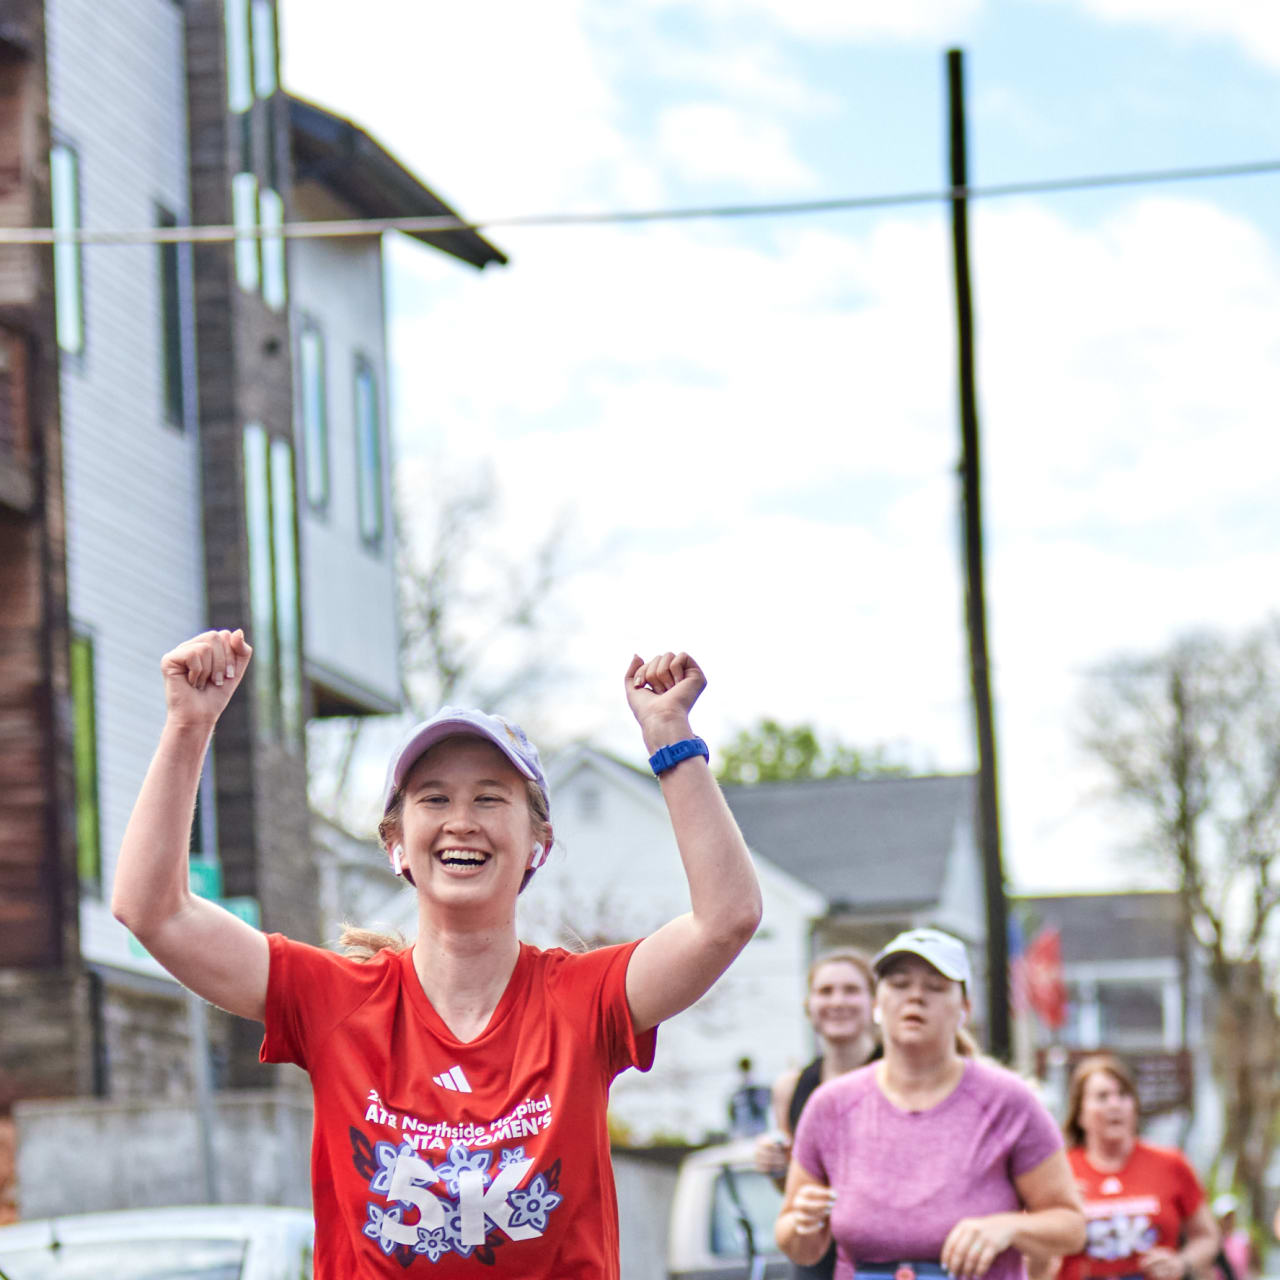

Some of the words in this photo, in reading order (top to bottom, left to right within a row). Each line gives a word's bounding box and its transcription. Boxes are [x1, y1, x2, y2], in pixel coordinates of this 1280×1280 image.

[401, 1115, 486, 1139] Northside
[451, 1111, 553, 1147] WOMEN'S
[381, 1154, 544, 1246] 5K
